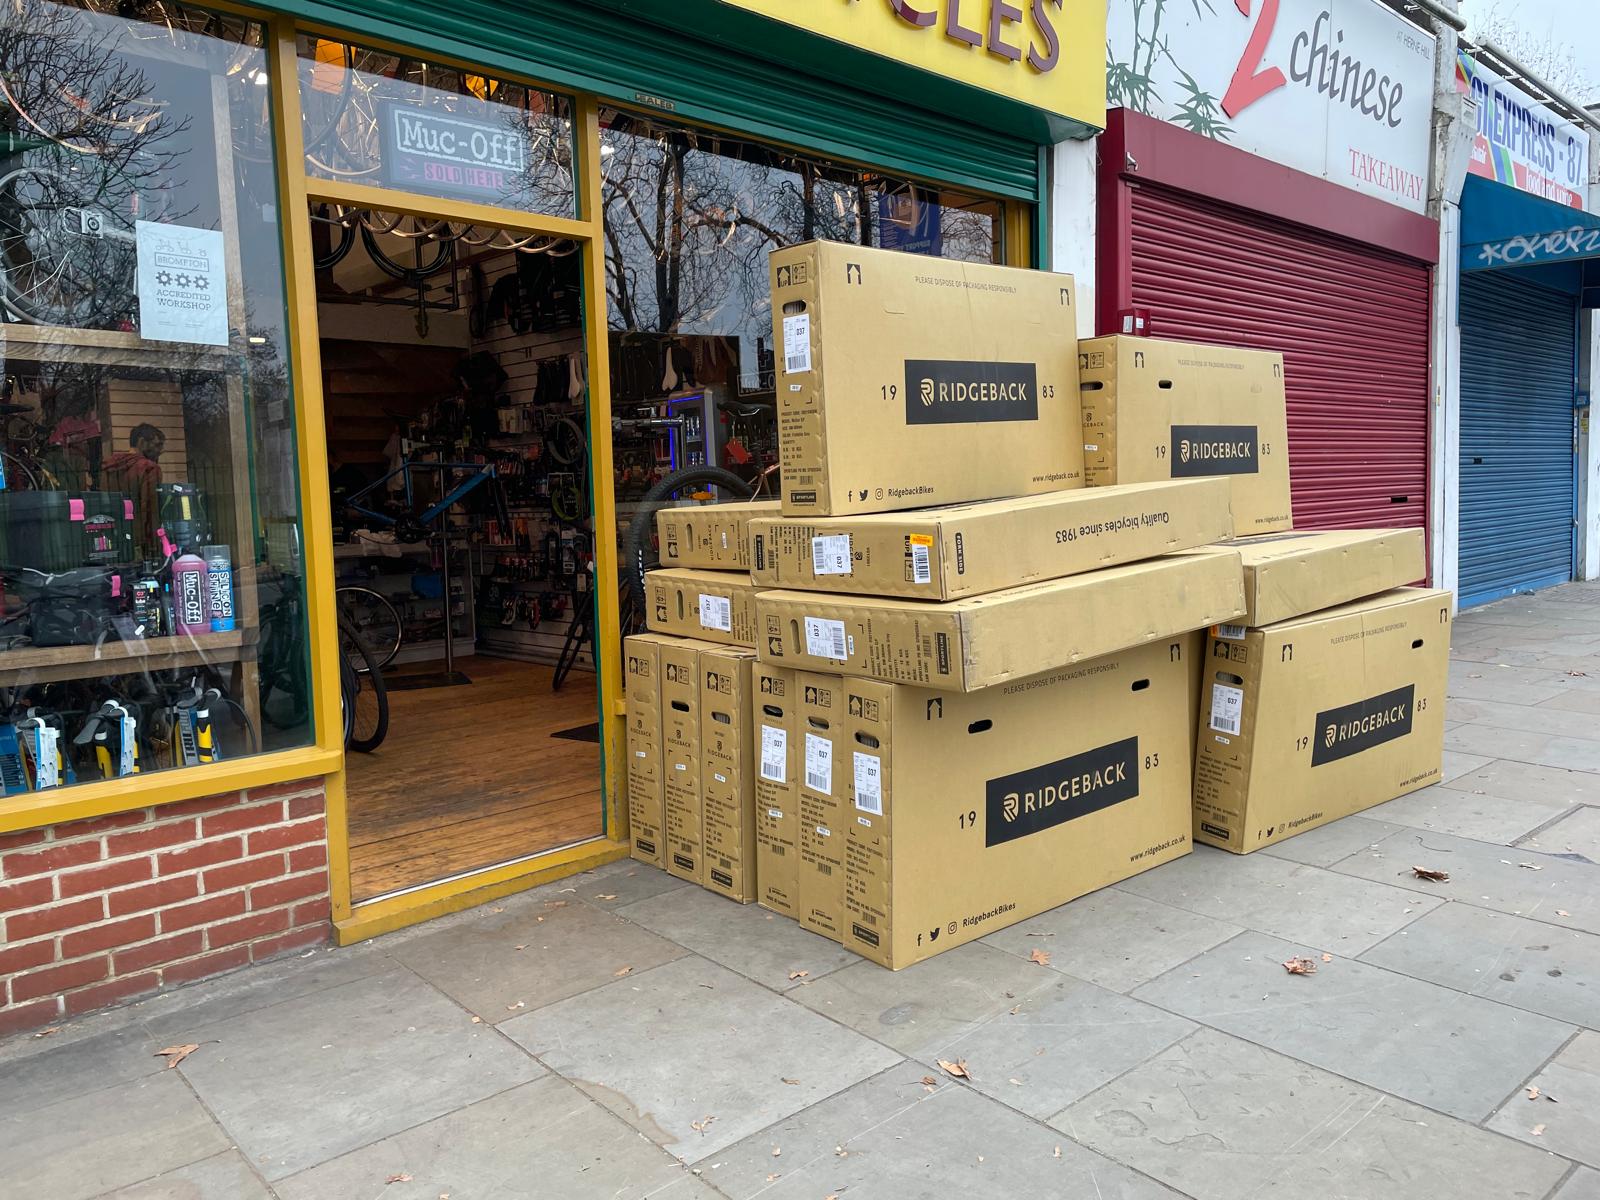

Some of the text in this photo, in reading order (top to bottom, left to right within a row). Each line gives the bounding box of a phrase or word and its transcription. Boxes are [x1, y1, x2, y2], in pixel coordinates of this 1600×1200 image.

[887, 0, 1062, 73] LES
[1403, 35, 1421, 54] HERNE
[1421, 45, 1430, 60] HILL
[1290, 11, 1403, 128] chinese
[402, 117, 517, 165] Muc-Off
[1493, 89, 1555, 174] EXPRESS
[1567, 135, 1583, 186] 87
[426, 163, 504, 189] SOLD HERE
[1348, 147, 1424, 201] TAKEAWAY
[157, 255, 207, 269] BROMPTON
[157, 289, 211, 301] ACCREDITED
[915, 276, 934, 285] PLEASE
[934, 278, 955, 288] DISPOSE
[157, 298, 212, 311] WORKSHOP
[881, 382, 1054, 402] 19 RIDGEBACK 83
[1155, 442, 1270, 460] 19 RIDGEBACK 83
[1032, 472, 1080, 483] www.ridgeback.co.uk
[888, 486, 934, 498] RidgebackBikes
[1055, 511, 1169, 543] Quality bicycles since 1983
[185, 573, 201, 622] Muc-Off
[1003, 662, 1120, 696] PLEASE DISPOSE OF PACKAGING RESPONSIBLY
[1296, 698, 1427, 752] 19 RIDGEBACK 83
[774, 740, 783, 748] 037
[819, 750, 828, 758] 037
[868, 768, 876, 776] 037
[959, 753, 1159, 830] 19 RIDGEBACK 83
[1130, 834, 1186, 862] www.ridgeback.co.uk
[962, 901, 1016, 928] RidgebackBikes
